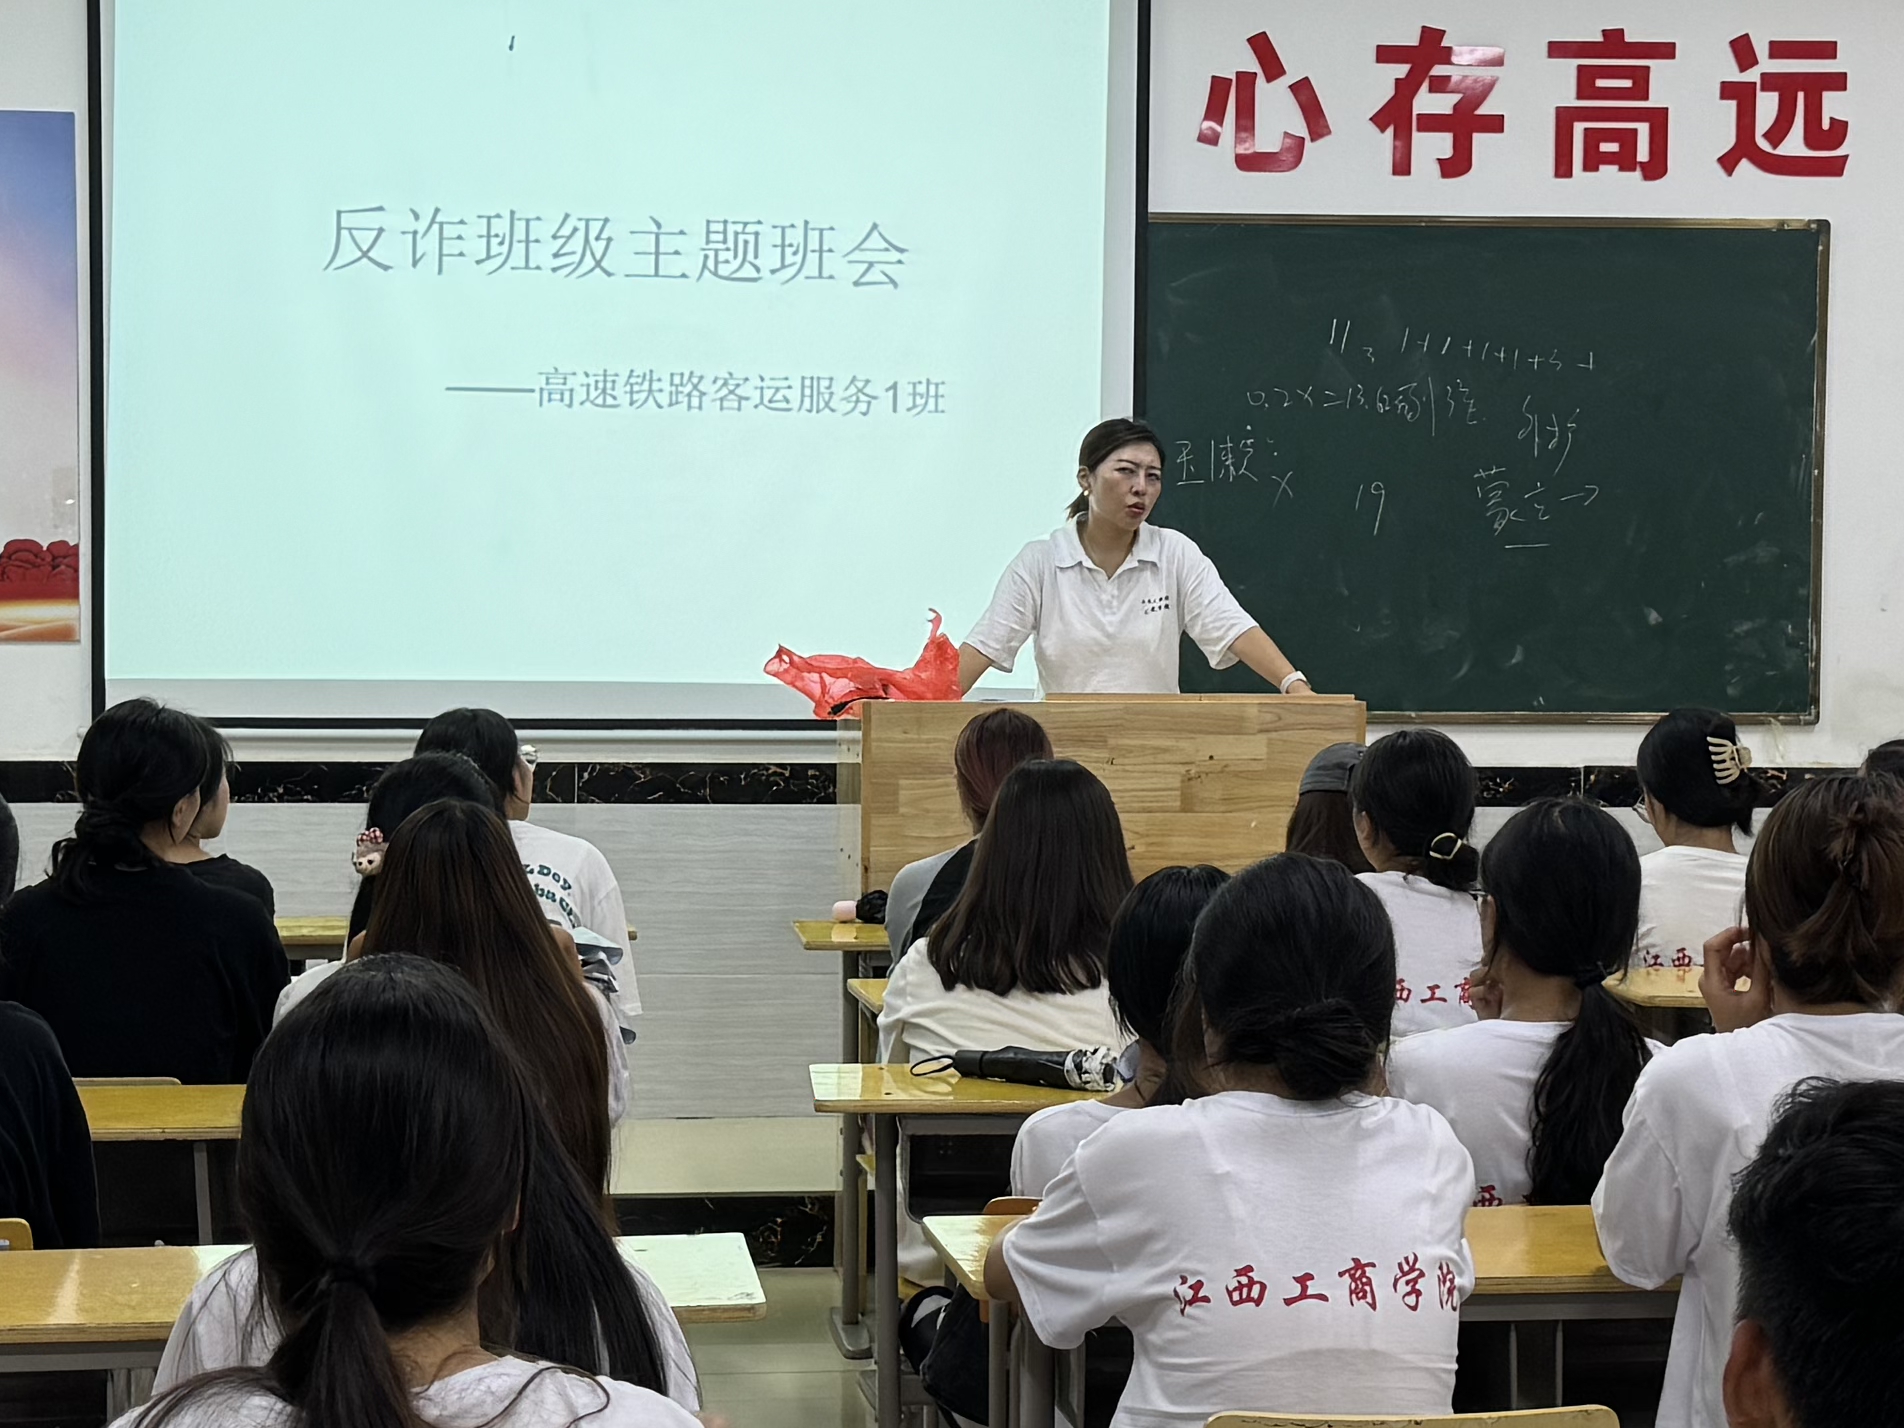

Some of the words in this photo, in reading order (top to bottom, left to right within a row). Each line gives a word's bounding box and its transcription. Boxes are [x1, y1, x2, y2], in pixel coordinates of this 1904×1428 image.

[1197, 25, 1850, 181] 心存高远
[323, 205, 910, 290] 反诈班级主题班会
[1173, 1251, 1458, 1317] 江西工商学院
